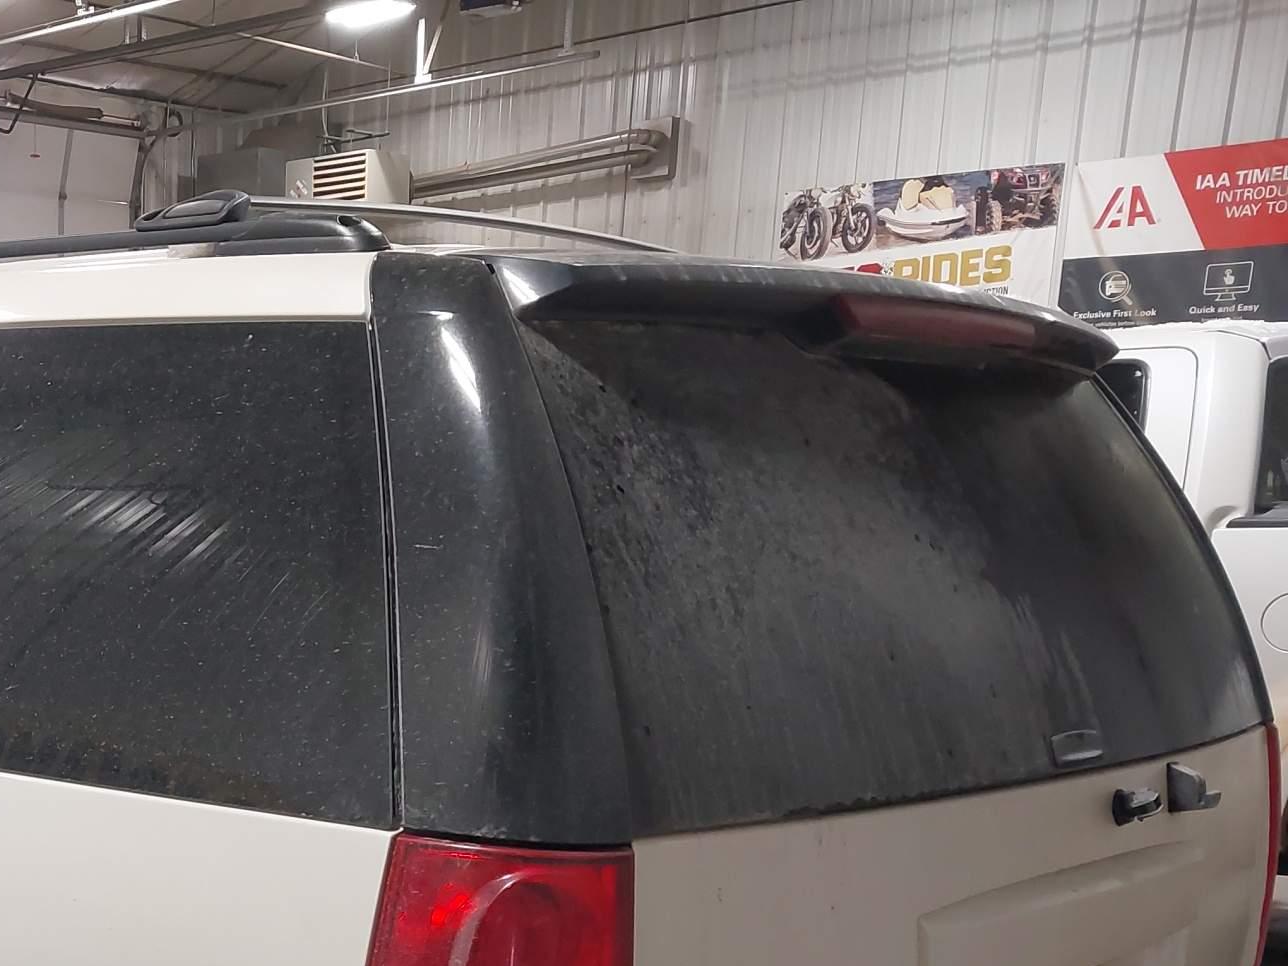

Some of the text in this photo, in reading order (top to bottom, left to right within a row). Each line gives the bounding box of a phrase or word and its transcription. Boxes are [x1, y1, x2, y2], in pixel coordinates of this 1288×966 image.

[1195, 172, 1230, 190] IAA
[1225, 199, 1288, 218] WAY TO
[1073, 307, 1157, 320] Exclusive First Look
[1189, 302, 1261, 315] Quick and Easy
